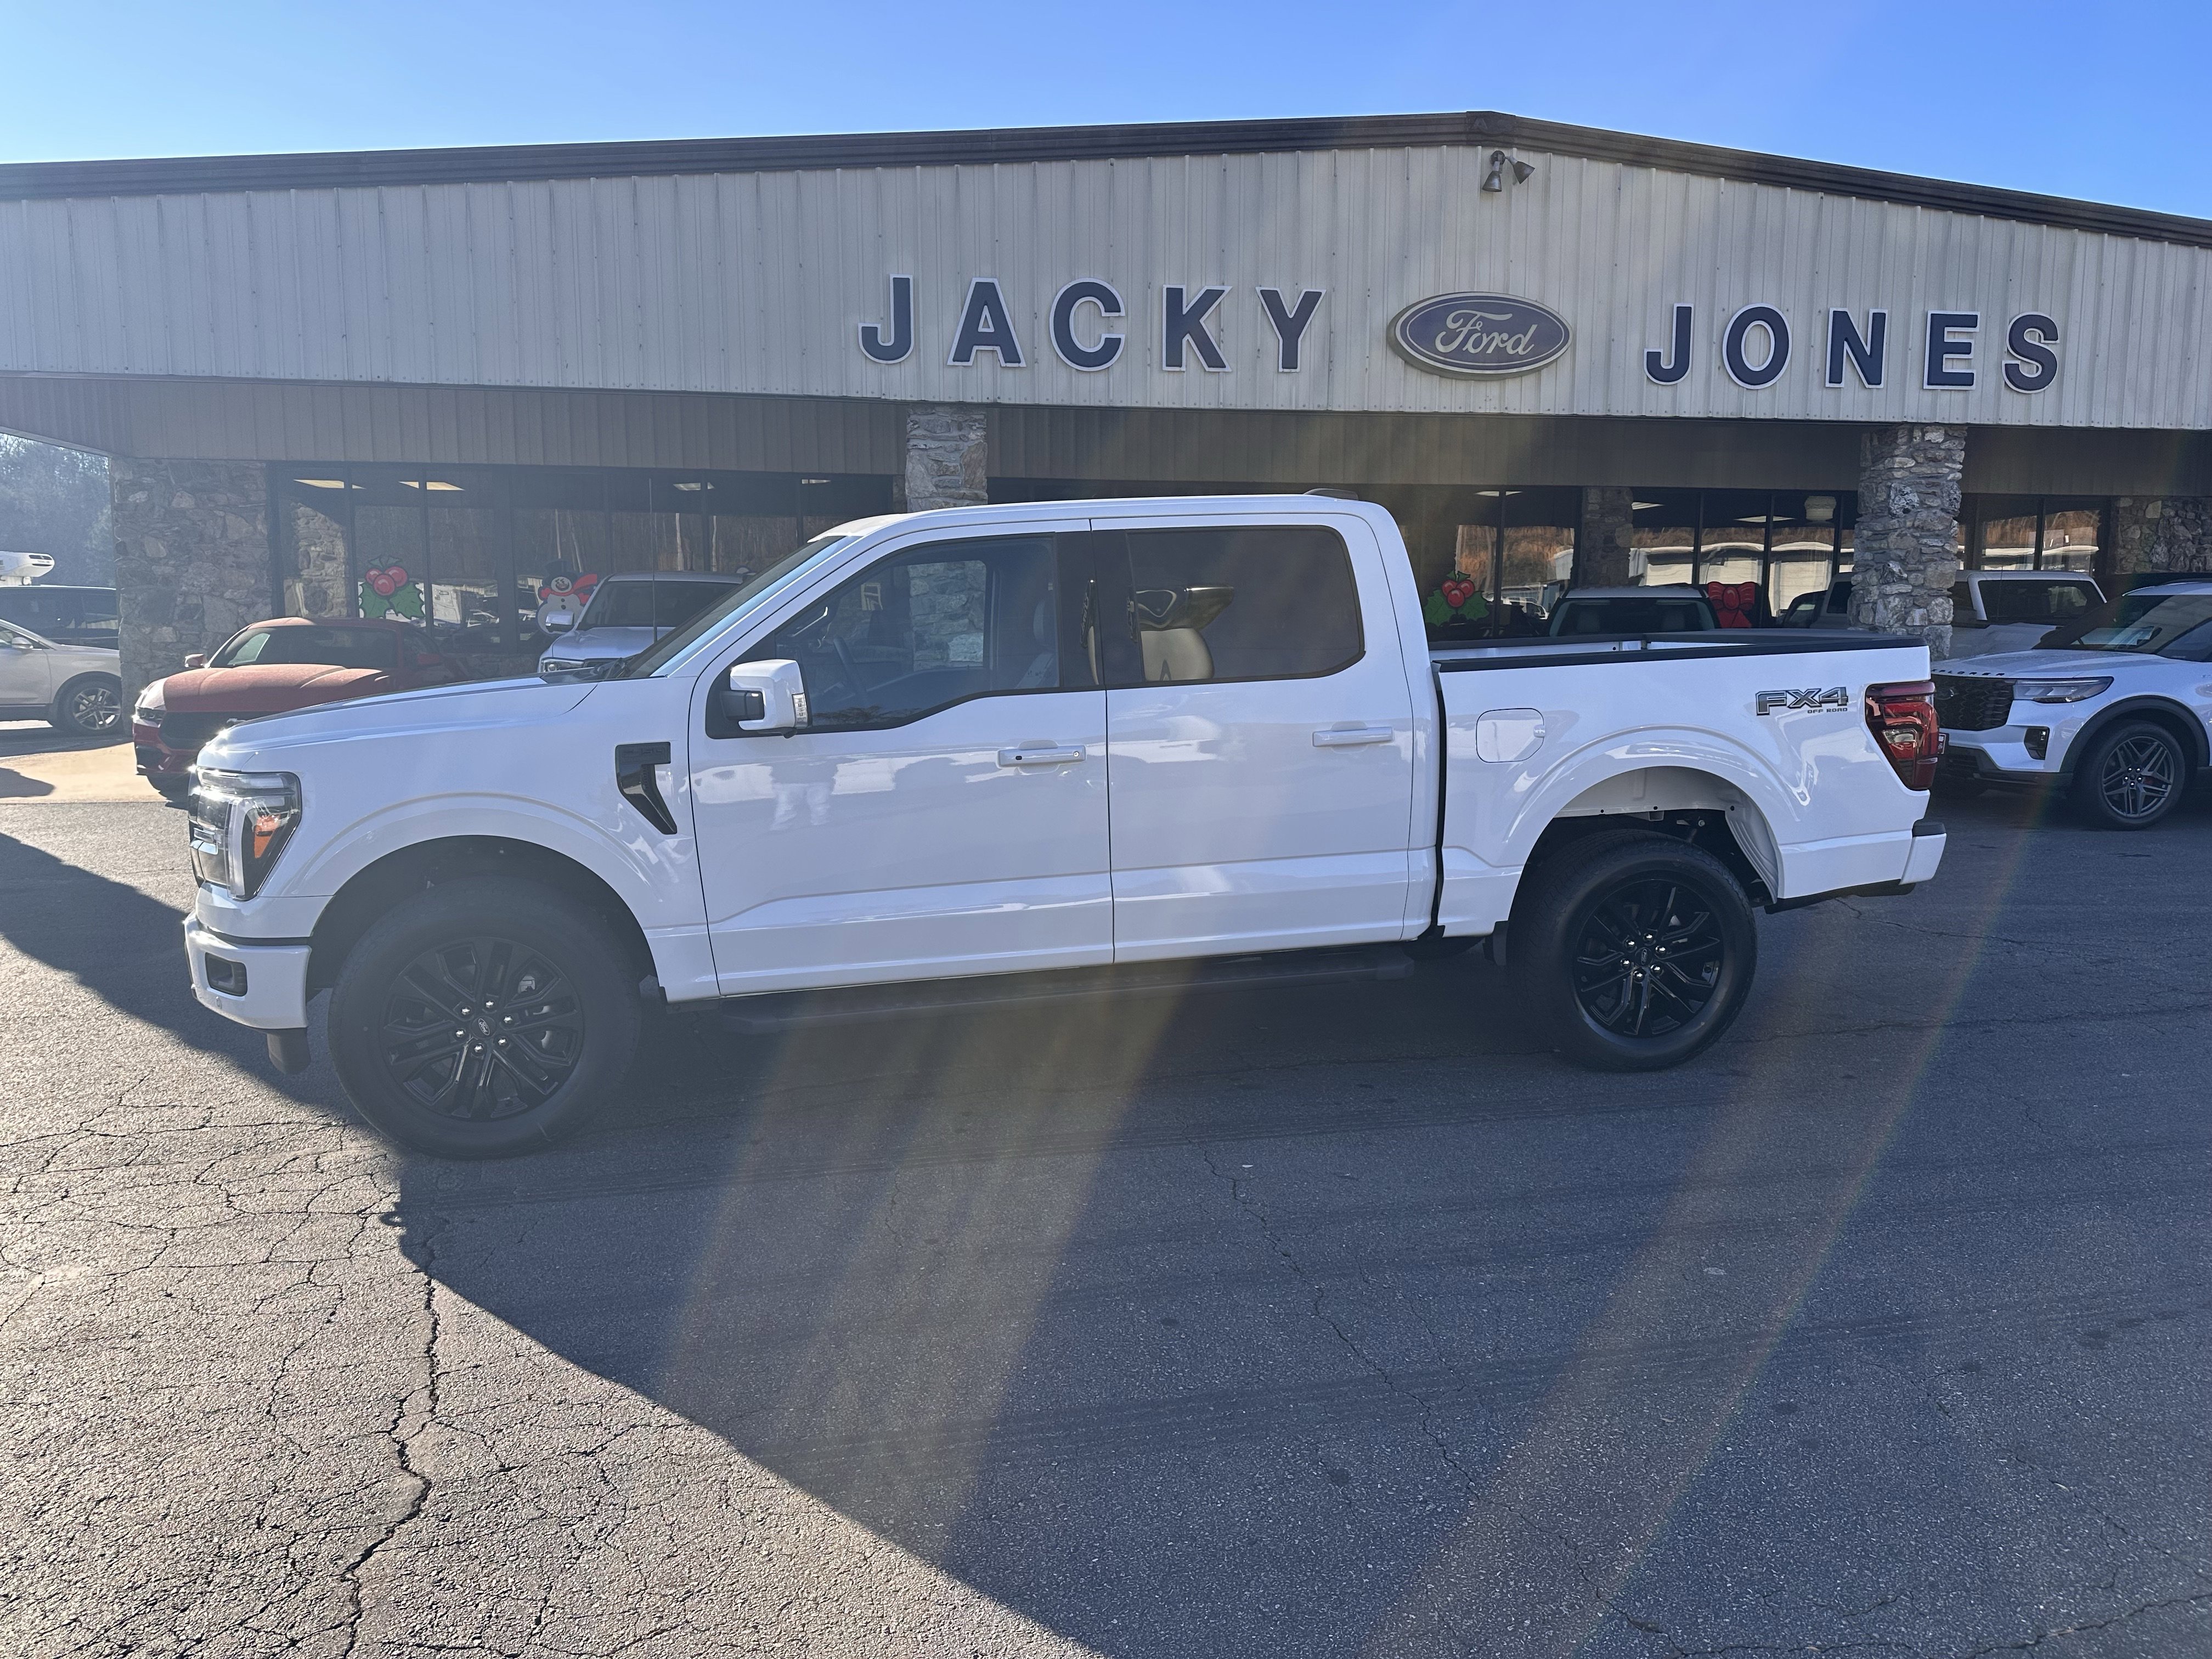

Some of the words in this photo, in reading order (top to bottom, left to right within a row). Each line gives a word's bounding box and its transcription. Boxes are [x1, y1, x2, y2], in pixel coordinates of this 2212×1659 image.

[858, 274, 1327, 373] JACKY
[1644, 302, 2060, 394] JONES
[1435, 309, 1538, 356] Ford
[1756, 686, 1849, 716] FX4
